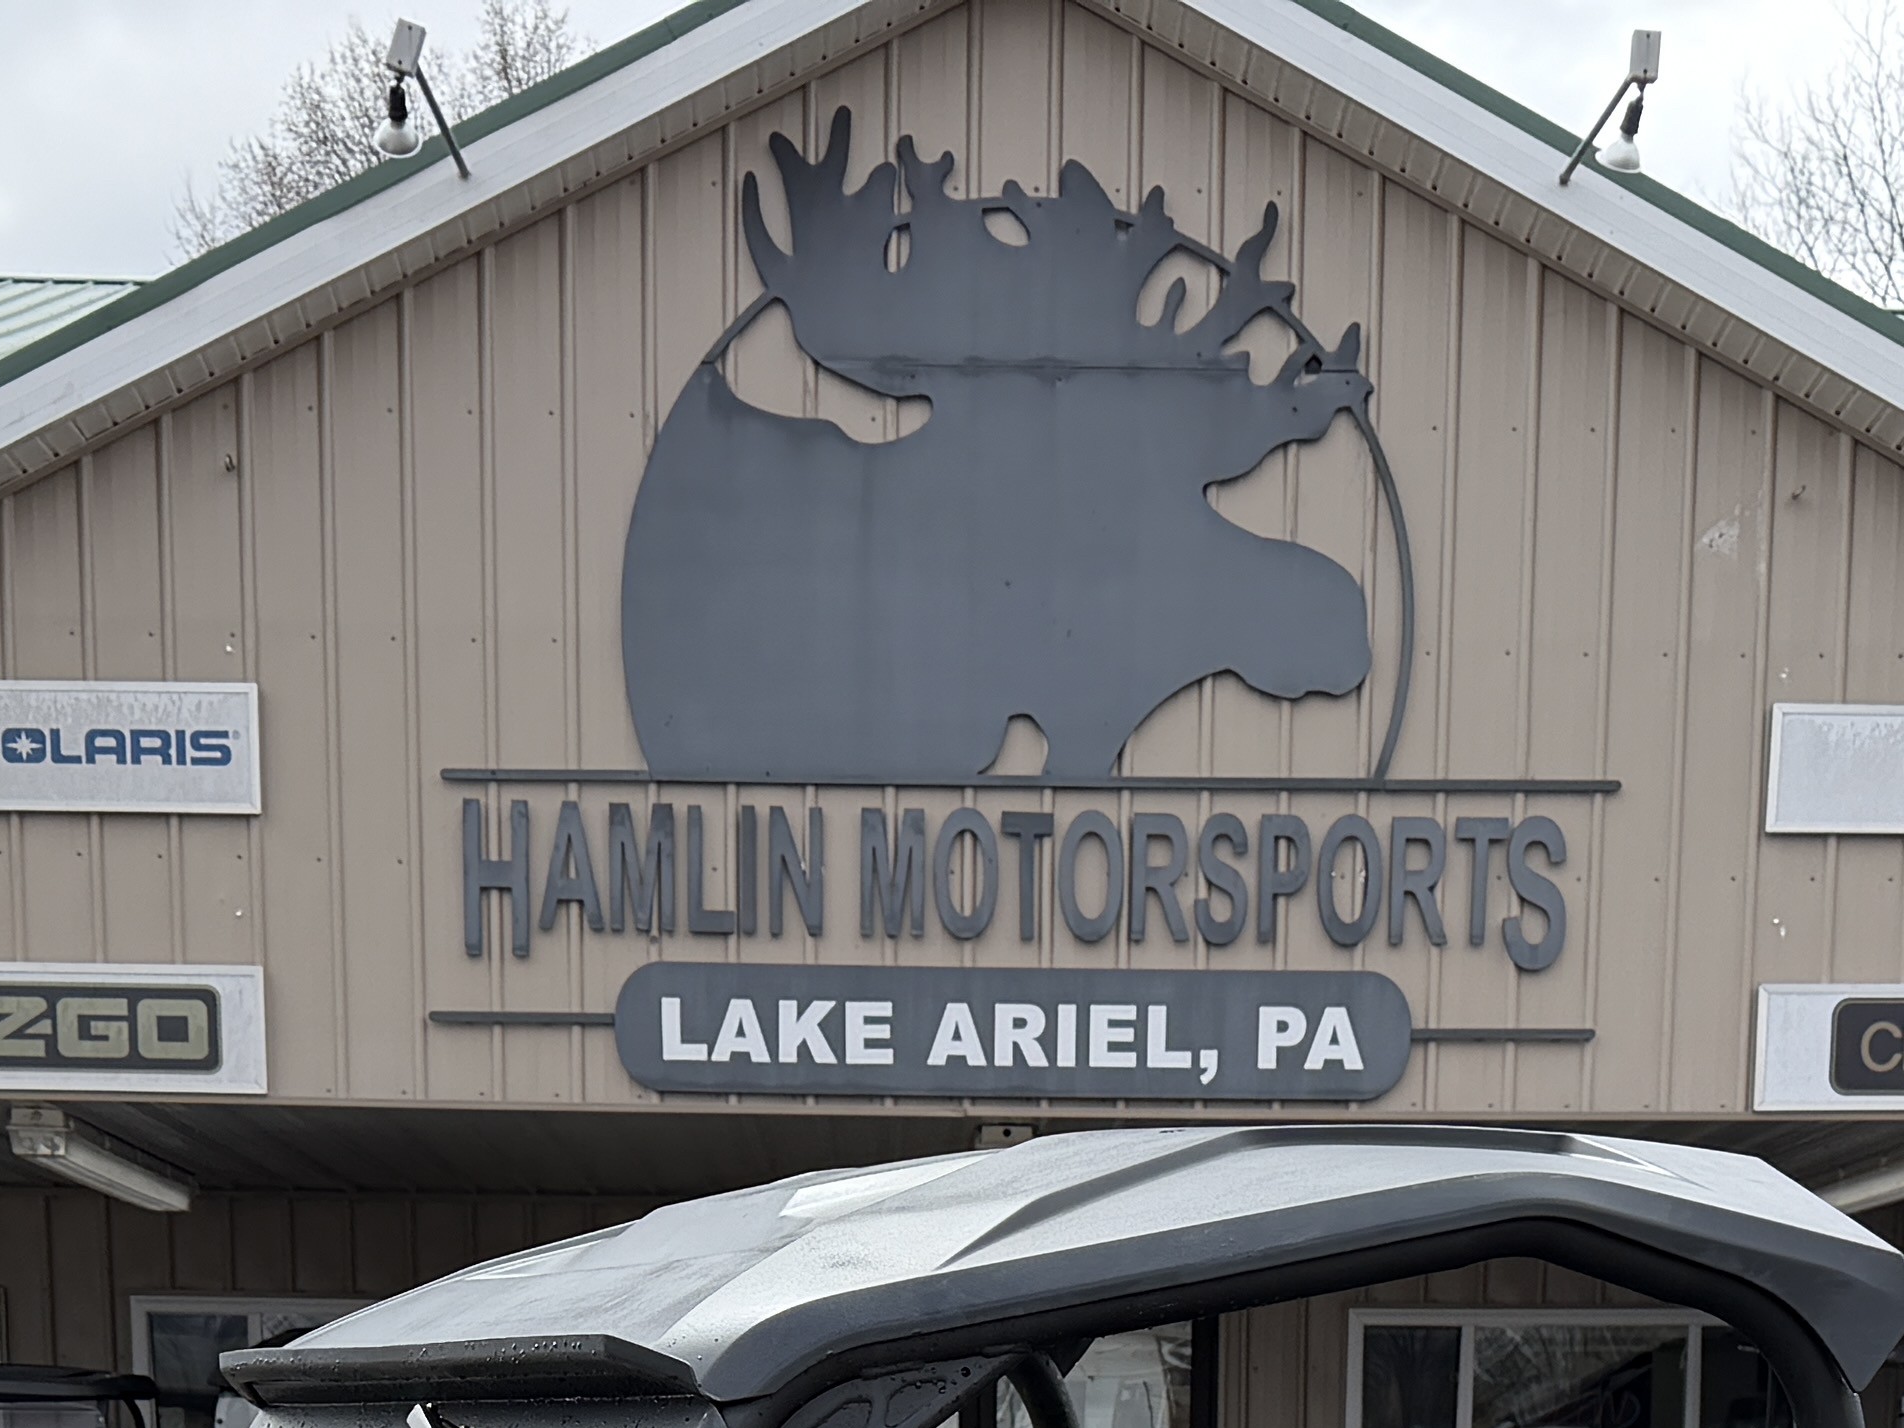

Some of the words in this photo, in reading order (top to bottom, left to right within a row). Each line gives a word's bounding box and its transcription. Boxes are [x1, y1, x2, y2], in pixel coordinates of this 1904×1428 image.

[462, 797, 824, 958] HAMLIN
[859, 806, 1568, 972] MOTORSPORTS
[661, 997, 894, 1064] LAKE
[926, 1003, 1219, 1085] ARIEL,
[1257, 1005, 1364, 1071] PA
